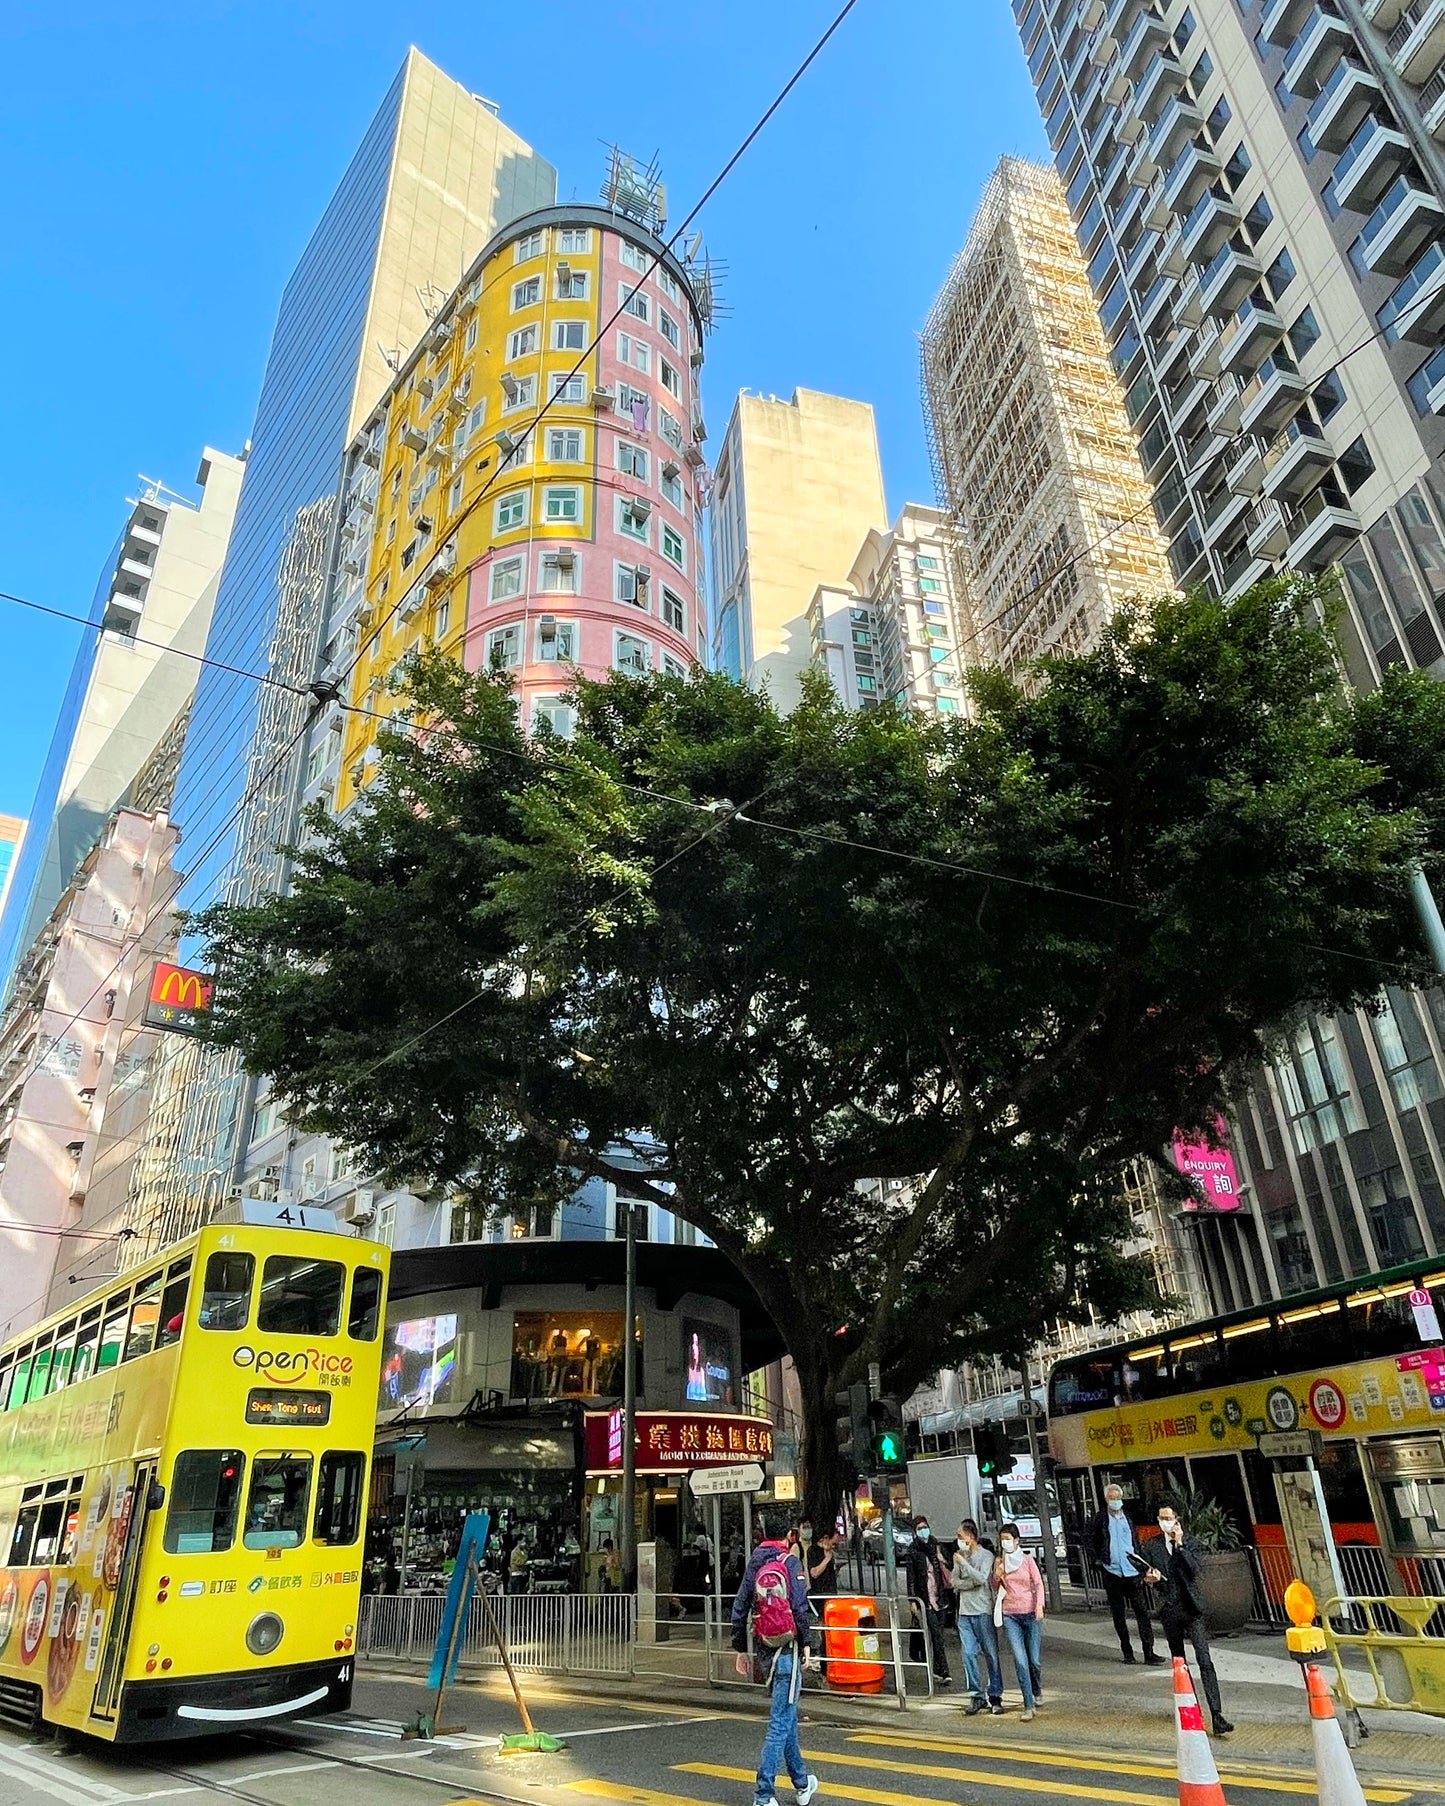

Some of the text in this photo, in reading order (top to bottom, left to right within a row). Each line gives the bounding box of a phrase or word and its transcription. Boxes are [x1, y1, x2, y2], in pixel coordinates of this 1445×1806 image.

[178, 1012, 196, 1026] 24
[1184, 1160, 1227, 1170] ENQUIRY
[275, 1207, 306, 1227] 41
[218, 1233, 235, 1248] 41
[369, 1251, 383, 1265] 41
[233, 1346, 353, 1374] OpenRice
[277, 1403, 299, 1415] Tong
[302, 1404, 322, 1415] Tsui
[210, 1579, 237, 1594] 訂座
[338, 1665, 350, 1682] 41
